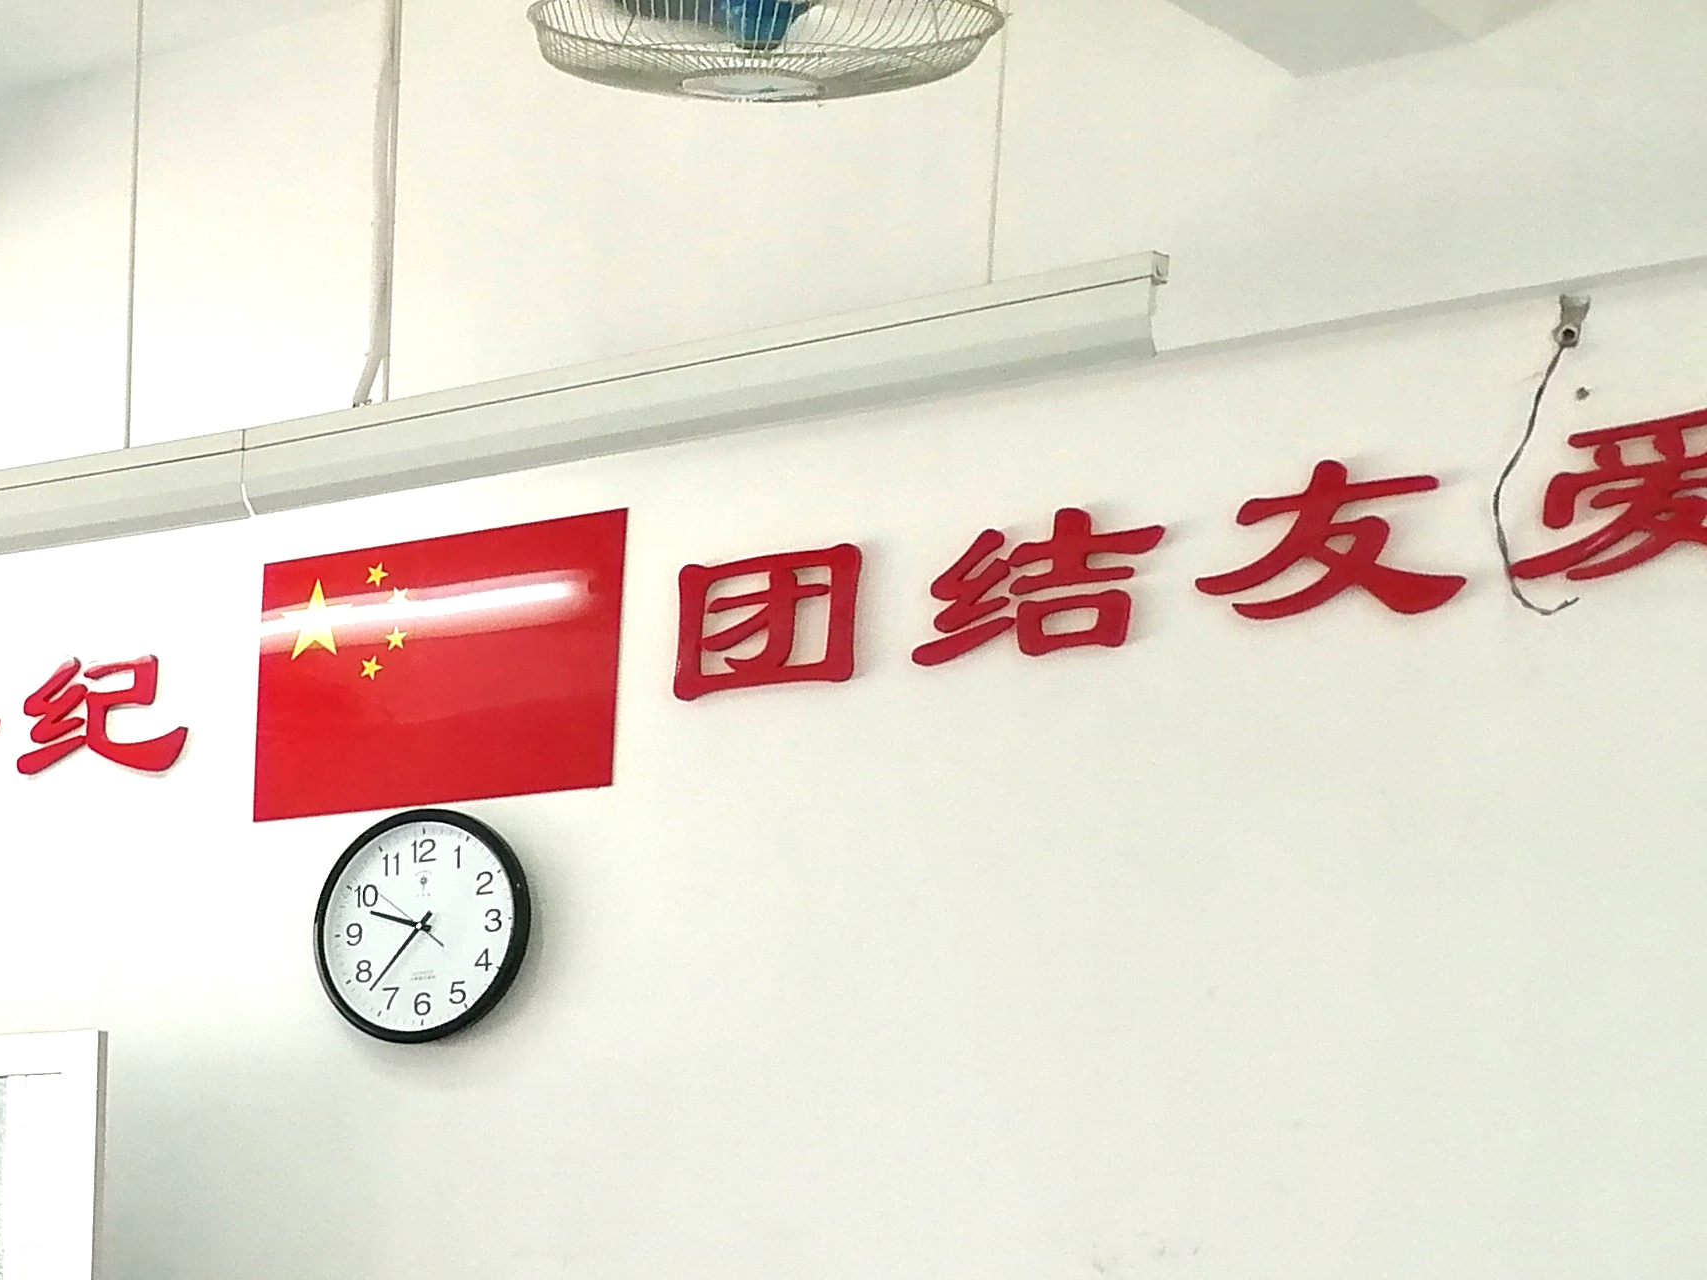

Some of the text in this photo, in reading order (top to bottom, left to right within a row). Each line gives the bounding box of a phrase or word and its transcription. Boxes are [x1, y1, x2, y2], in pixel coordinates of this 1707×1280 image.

[673, 409, 1707, 702] 团结友爱
[411, 838, 437, 863] 12
[454, 845, 461, 869] 1
[382, 852, 400, 876] 11
[475, 871, 494, 896] 2
[354, 884, 379, 908] 10
[484, 908, 503, 933] 3
[346, 922, 363, 946] 9
[355, 960, 372, 983] 8
[474, 948, 493, 972] 4
[382, 986, 400, 1010] 7
[413, 992, 432, 1016] 6
[448, 981, 467, 1004] 5
